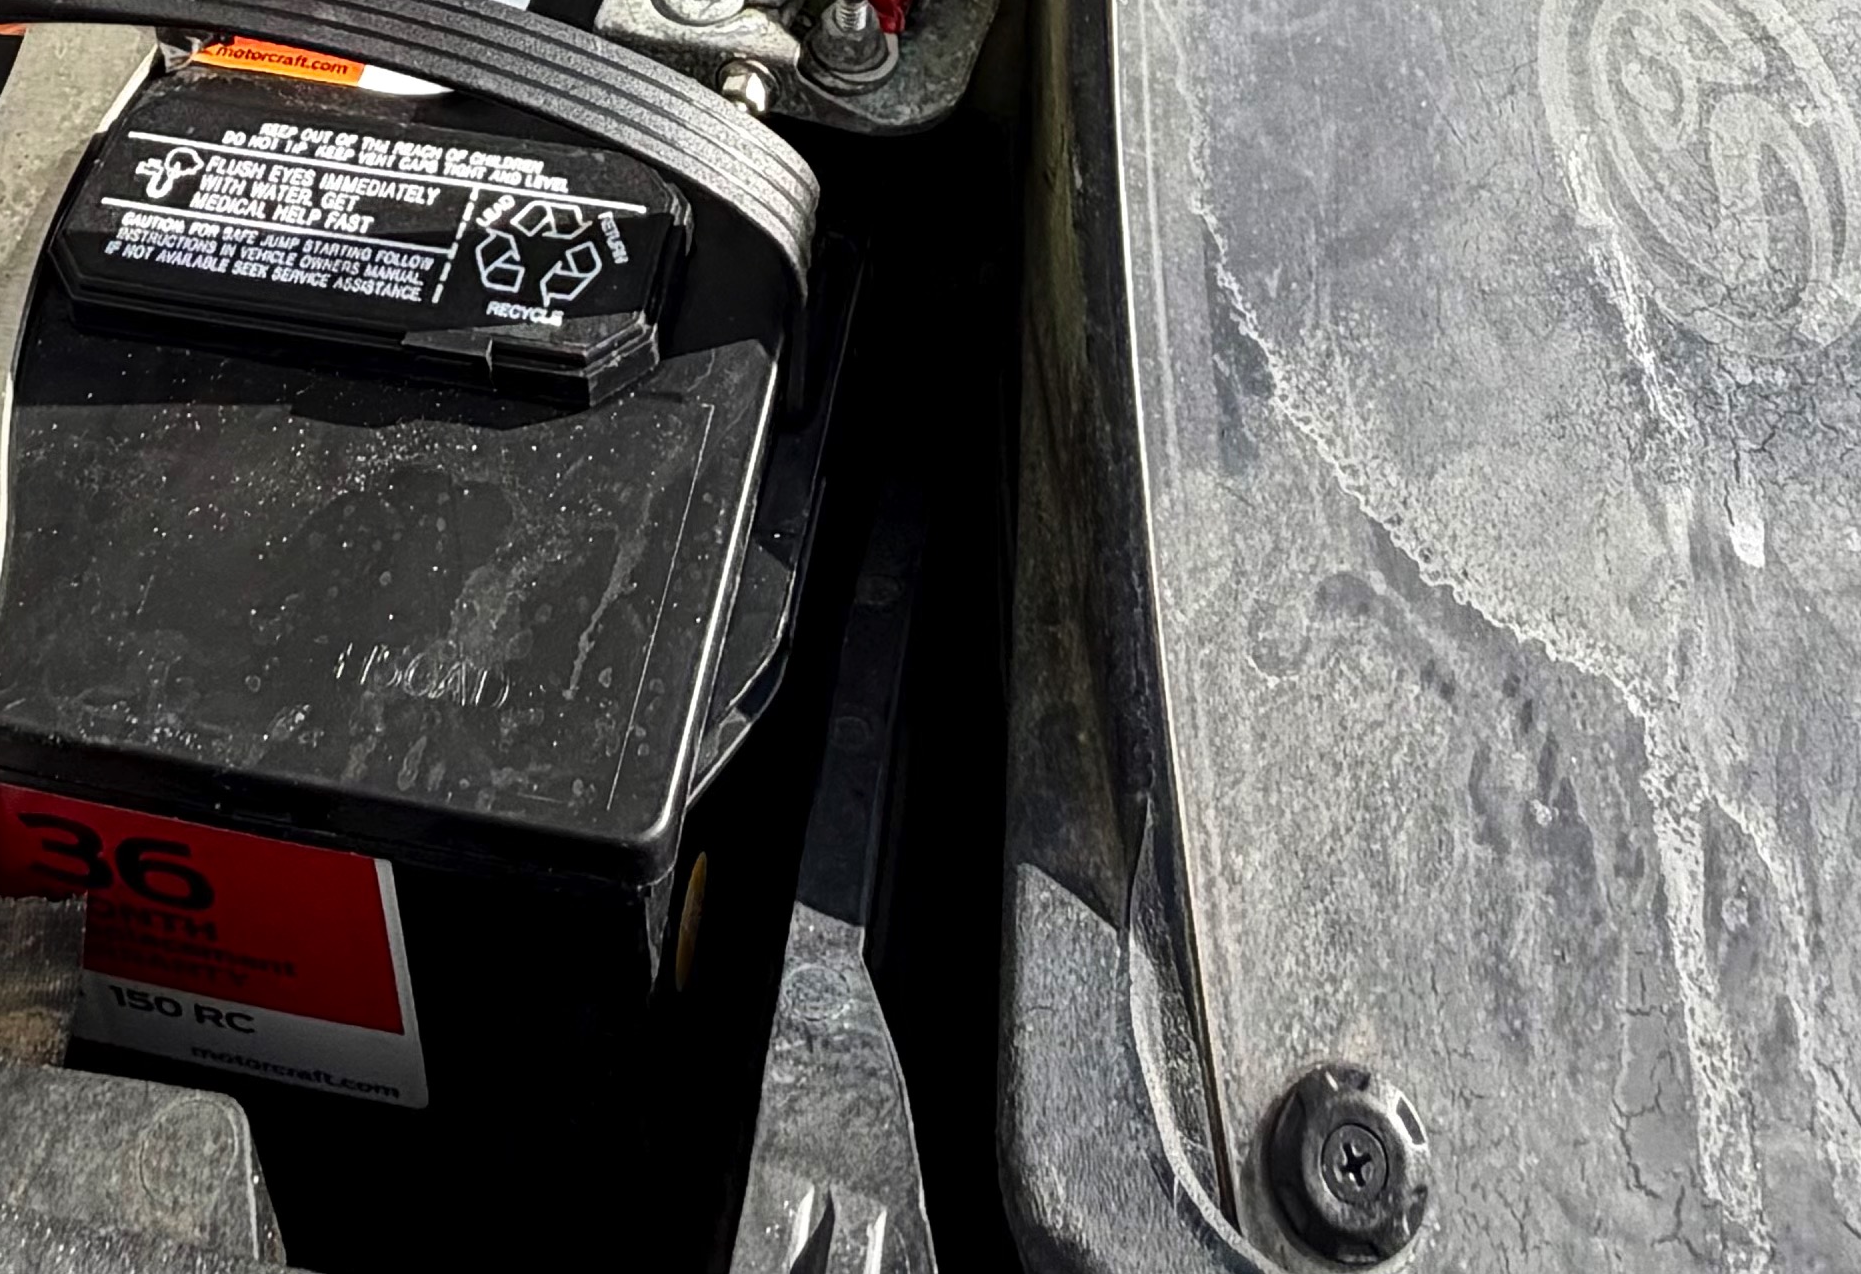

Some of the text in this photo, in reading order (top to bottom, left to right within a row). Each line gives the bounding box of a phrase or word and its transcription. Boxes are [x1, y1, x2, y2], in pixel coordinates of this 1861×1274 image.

[217, 42, 349, 76] motorcraft.com
[222, 130, 247, 146] DO
[248, 135, 278, 150] NOT
[315, 144, 355, 160] KEEP
[358, 151, 395, 169] VENT
[398, 156, 438, 174] CAPS
[444, 161, 486, 180] TIGHT
[489, 169, 521, 186] AND
[524, 172, 568, 194] LEVEL
[260, 123, 298, 139] KEEP
[301, 128, 334, 144] OUT
[337, 134, 358, 149] OF
[392, 141, 442, 161] REACH
[447, 148, 467, 163] OF
[469, 151, 544, 174] CHILDREN
[199, 174, 247, 196] WITH
[321, 192, 360, 212] GET
[206, 155, 440, 206] FLUSH EYES IMMEDIATELY
[189, 192, 375, 234] MEDICAL HELP FAST
[105, 241, 122, 255] IF
[122, 244, 154, 260] NOT
[156, 250, 230, 273] AVAILABLE
[232, 260, 269, 278] SEEK
[271, 265, 332, 288] SERVICE
[116, 227, 217, 252] INSTRUCTIONS
[219, 242, 237, 256] IN
[240, 245, 297, 267] VEHICLE
[189, 222, 220, 238] FOR
[222, 226, 259, 245] SAFE
[260, 234, 300, 251] JUMP
[303, 240, 371, 263] STARTING
[375, 250, 435, 271] FOLLOW
[487, 300, 564, 327] RECYCLE
[19, 812, 215, 911] 36
[109, 984, 256, 1034] 150 RC
[191, 1046, 401, 1100] motorcraft.com
